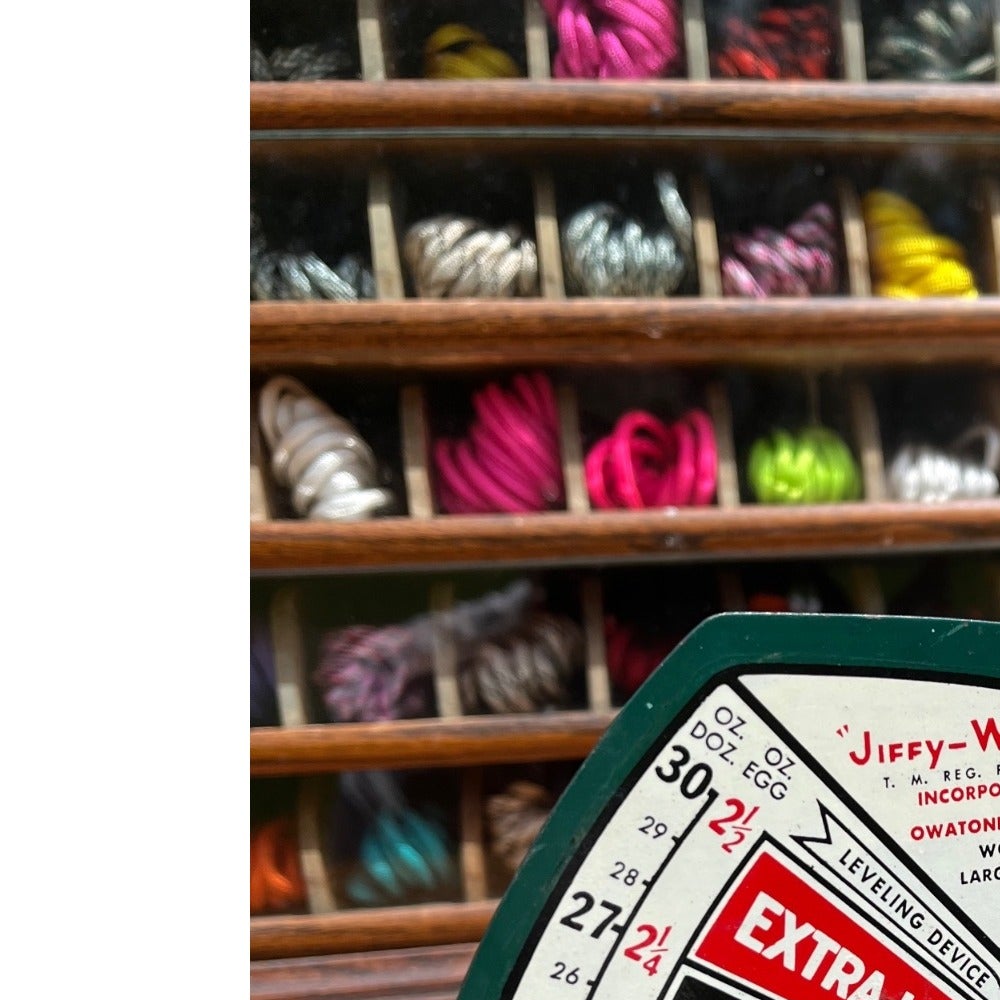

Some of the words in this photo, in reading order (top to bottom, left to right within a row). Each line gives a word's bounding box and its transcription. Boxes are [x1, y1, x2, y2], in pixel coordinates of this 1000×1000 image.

[714, 706, 747, 740] OZ.
[690, 720, 738, 766] DOZ.
[655, 745, 713, 800] 30
[742, 760, 788, 800] EGG
[764, 747, 796, 780] OZ.
[883, 776, 895, 789] T.
[911, 774, 928, 786] M.
[943, 767, 982, 782] REG.
[639, 815, 668, 839] 29
[609, 861, 639, 886] 28
[560, 891, 622, 939] 27
[838, 849, 925, 930] LEVELING
[927, 929, 991, 988] DEVICE
[550, 962, 580, 985] 26
